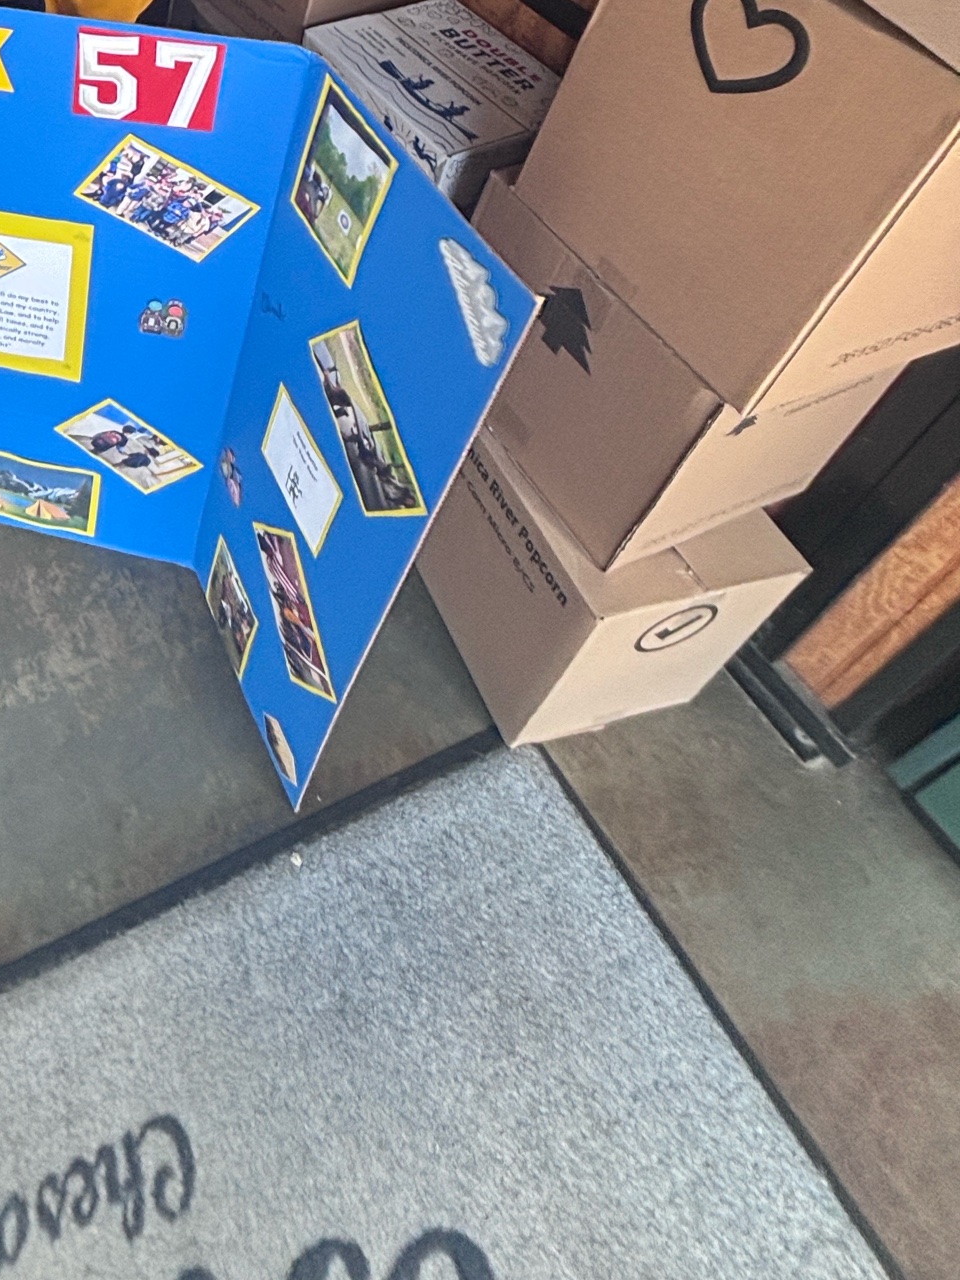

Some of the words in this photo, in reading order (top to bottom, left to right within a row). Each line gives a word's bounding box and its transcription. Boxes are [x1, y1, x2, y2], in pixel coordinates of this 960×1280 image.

[77, 30, 220, 129] 57
[439, 27, 536, 91] BUTTER
[461, 28, 542, 83] DOUBLE
[467, 481, 487, 514] Corn
[489, 478, 519, 527] River
[517, 525, 569, 608] Popcorn
[654, 614, 703, 641] 1
